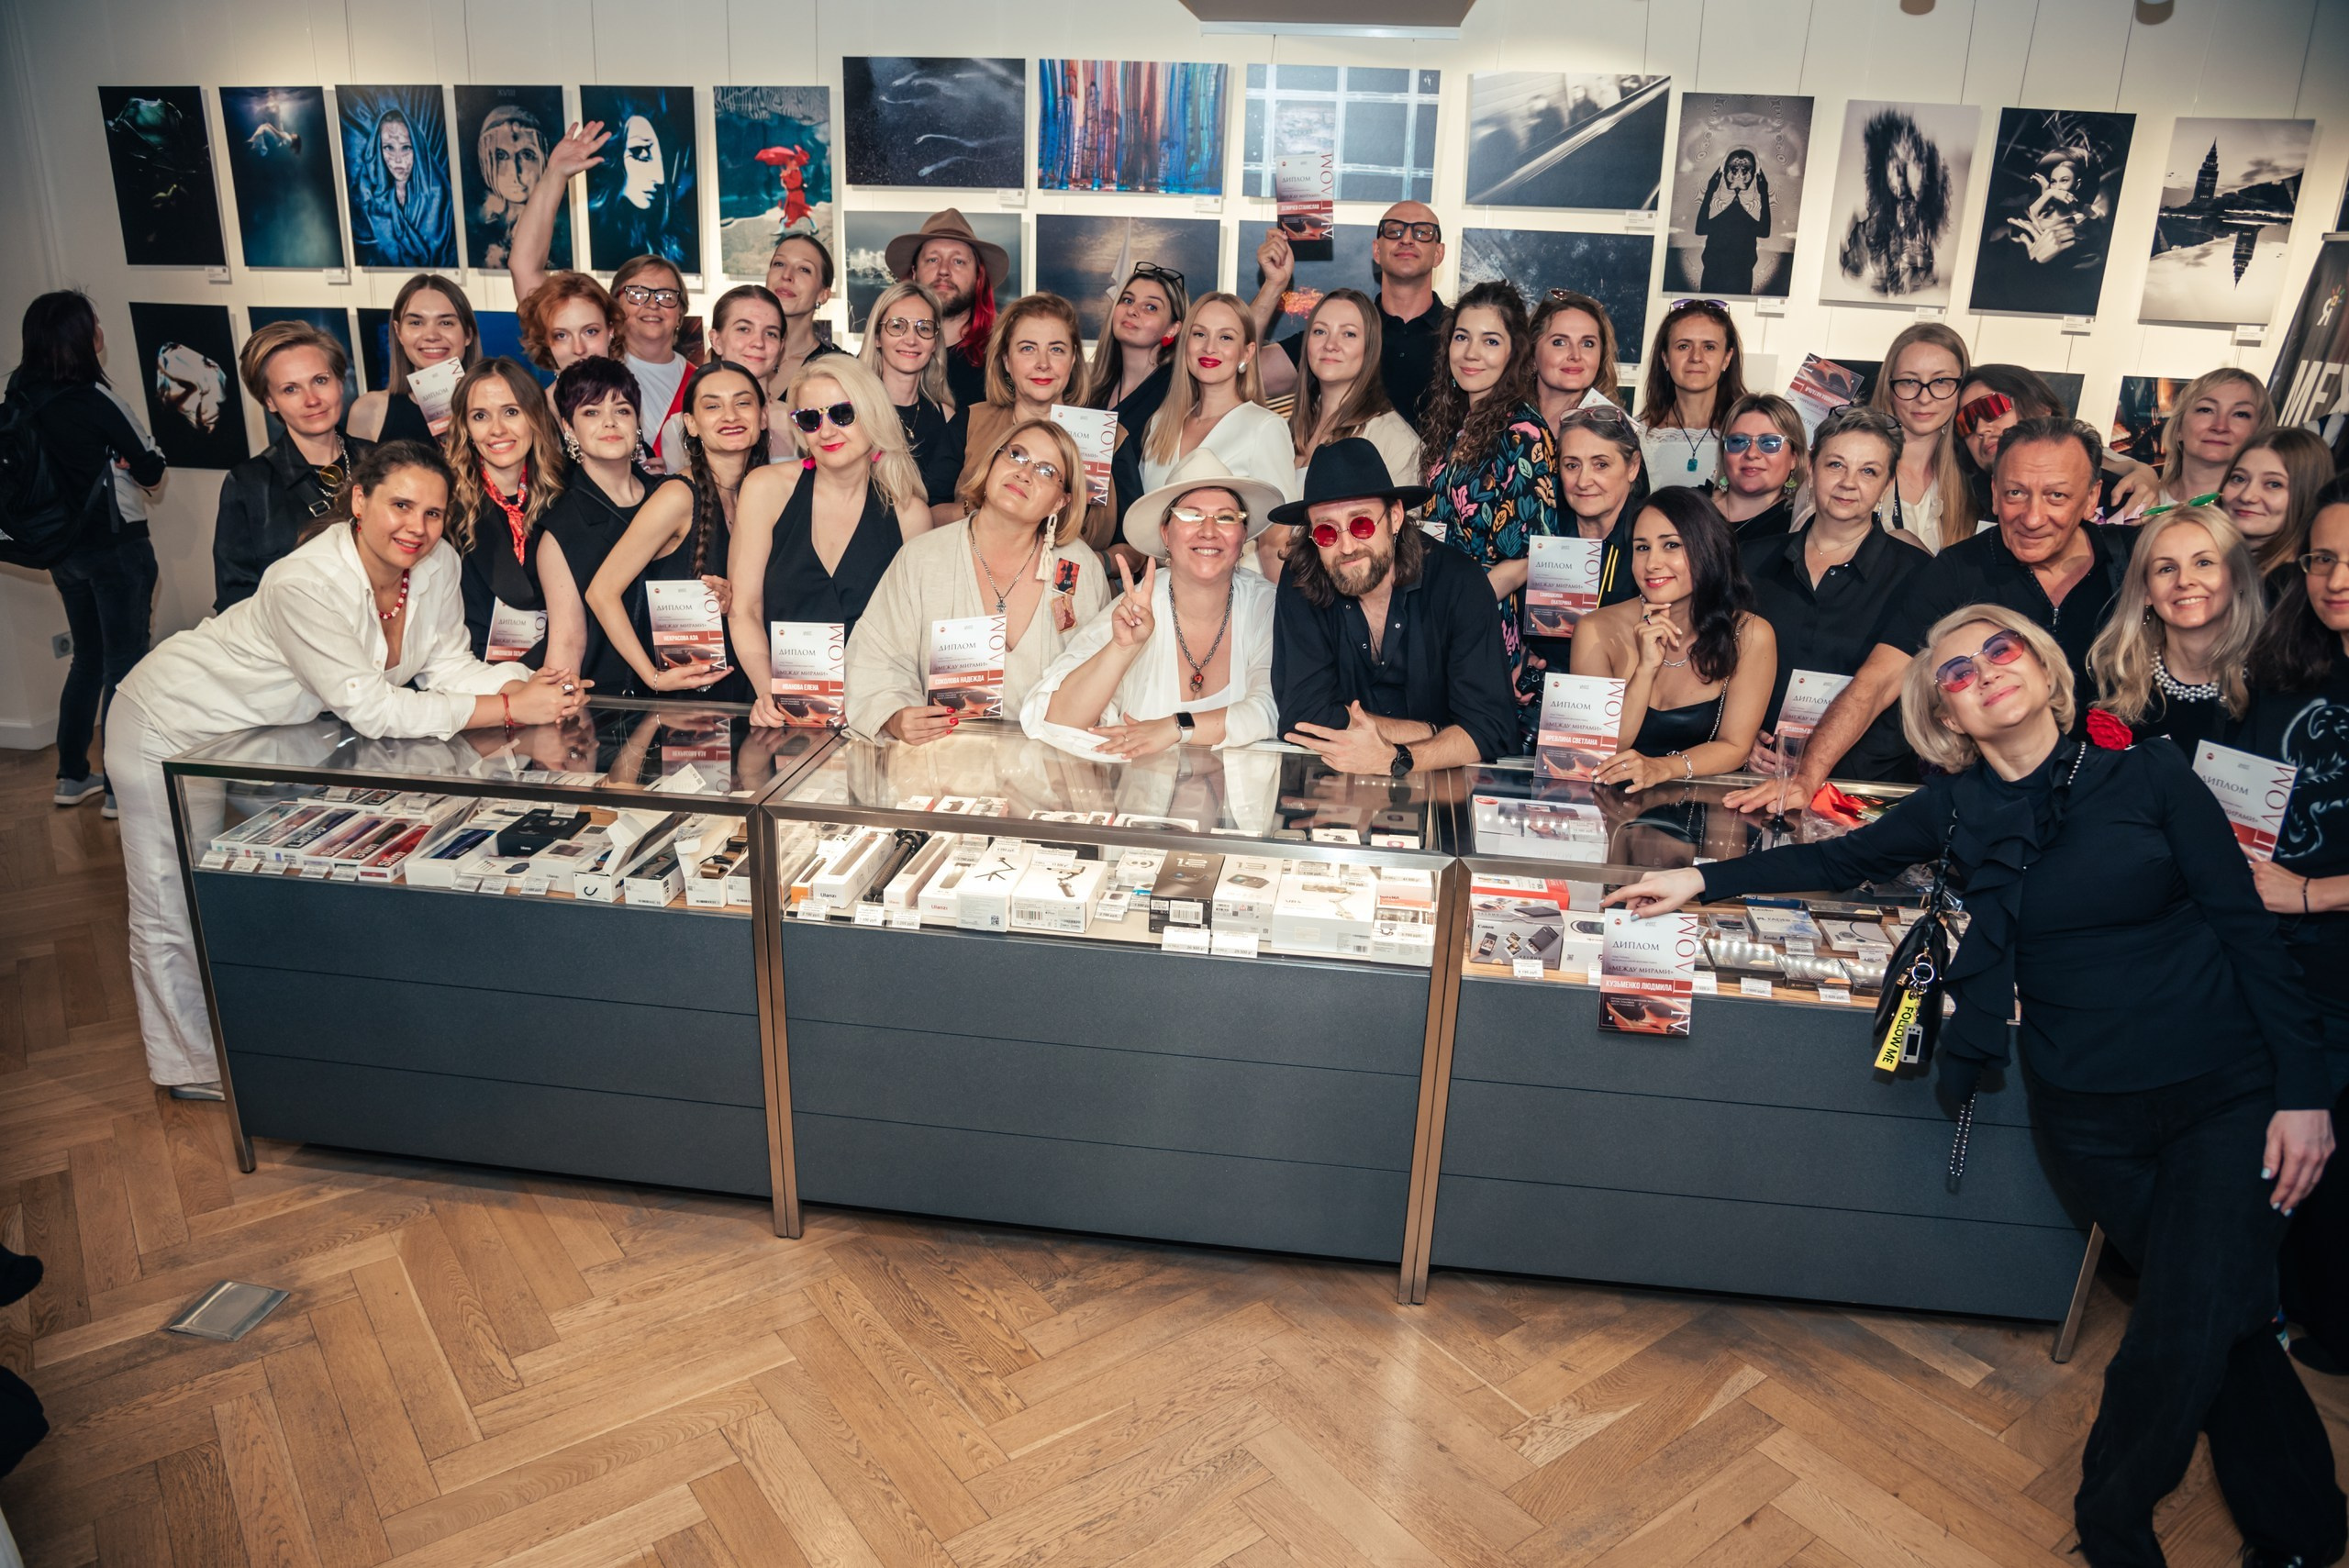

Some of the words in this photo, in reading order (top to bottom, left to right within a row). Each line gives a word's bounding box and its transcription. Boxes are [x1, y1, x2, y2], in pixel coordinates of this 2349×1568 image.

[1093, 413, 1119, 506] ДИПЛОМ
[1535, 561, 1573, 570] ДИПЛОМ
[778, 648, 817, 657] ДИПЛОМ
[938, 642, 976, 651] ДИПЛОМ
[986, 616, 1006, 717] ДИПЛОМ
[1550, 700, 1592, 711] ДИПЛОМ
[1572, 737, 1598, 746] СВЕТЛАНА
[319, 841, 349, 857] Slim
[351, 843, 380, 860] Slim
[377, 851, 406, 867] Slim
[1611, 940, 1660, 951] ДИПЛОМ
[1609, 964, 1638, 973] «МЕЖДУ
[1639, 966, 1674, 975] МИРАМИ»
[1670, 916, 1698, 1036] ДИПЛОМ
[1606, 979, 1641, 990] КУЗЬМЕНКО
[1641, 982, 1673, 992] ЛЮДМИЛА
[1890, 1006, 1914, 1048] FOLLOW
[1882, 1048, 1898, 1064] ME
